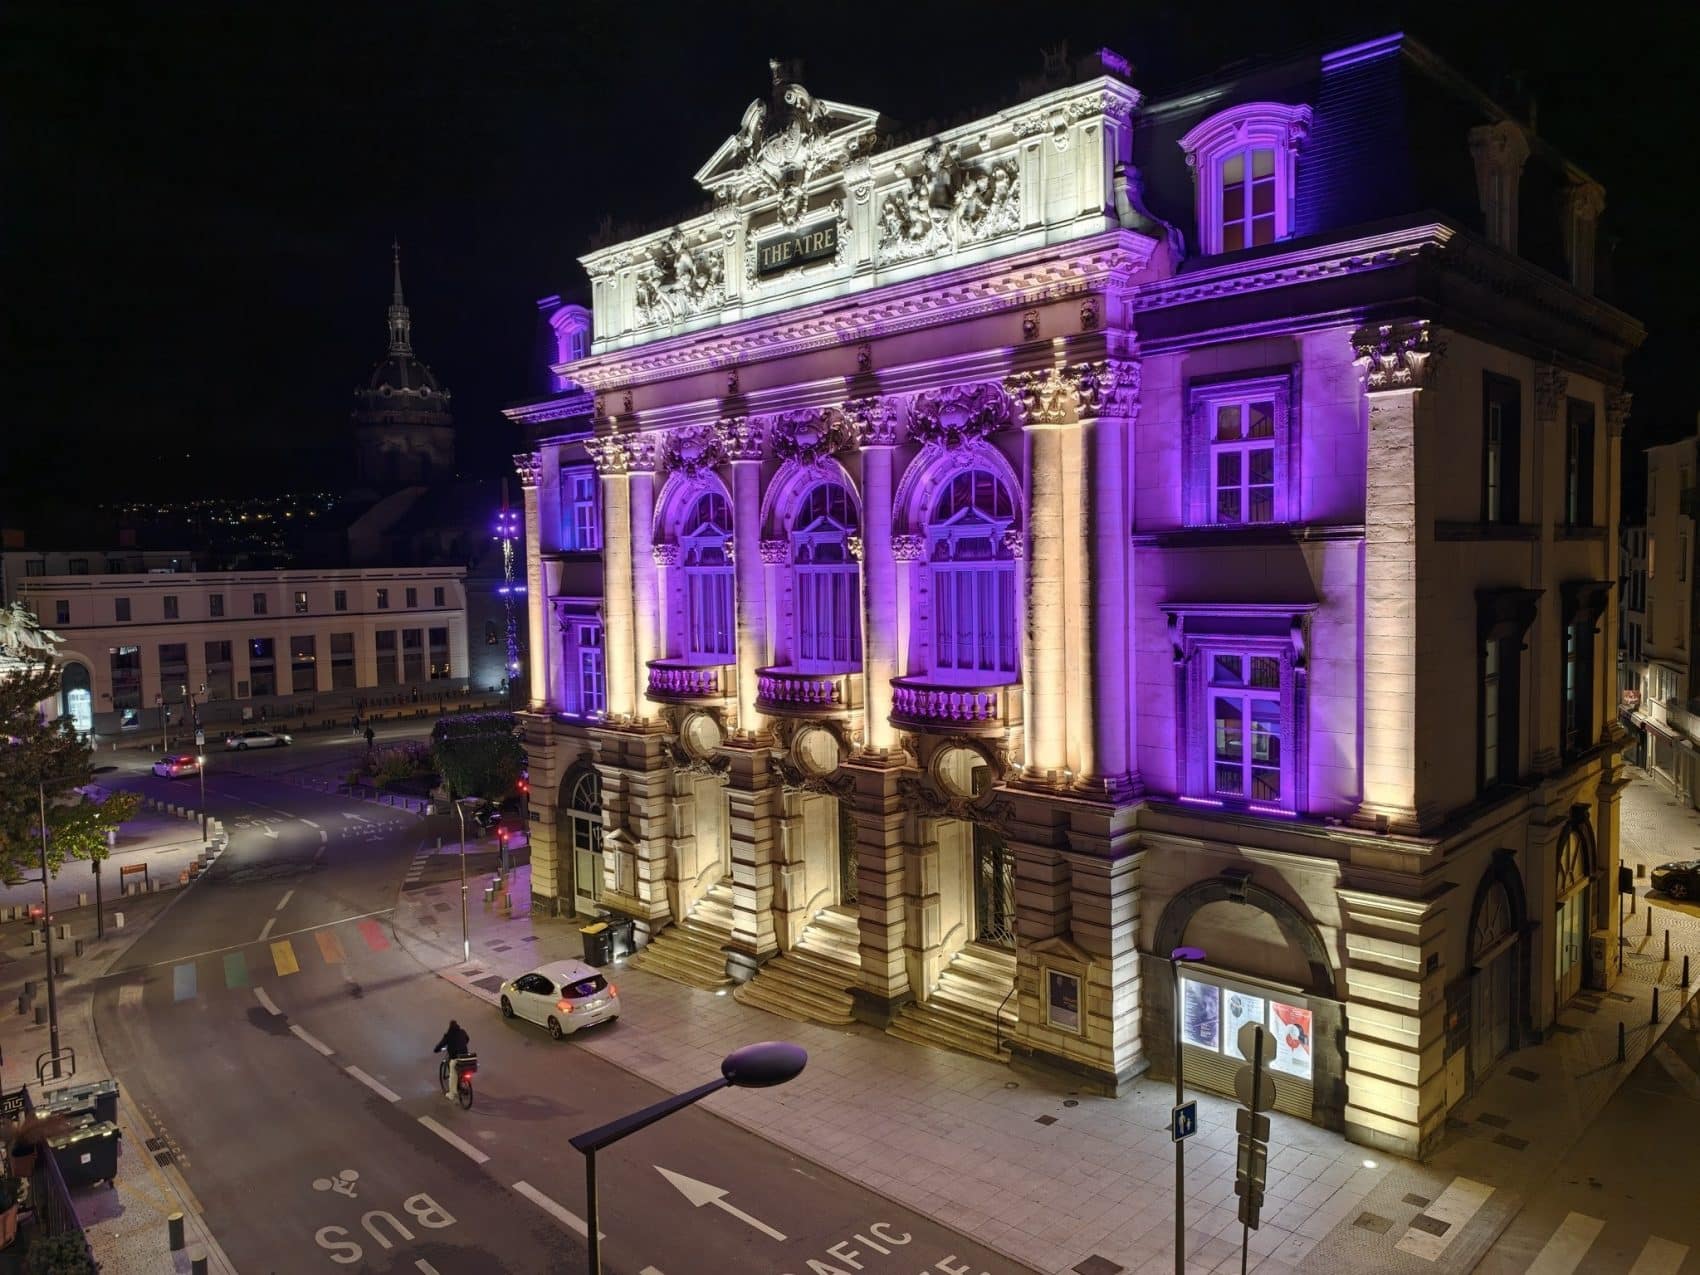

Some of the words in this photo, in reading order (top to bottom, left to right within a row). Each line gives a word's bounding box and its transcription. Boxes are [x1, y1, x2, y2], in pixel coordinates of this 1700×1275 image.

[762, 228, 834, 266] THEATRE
[314, 1193, 458, 1264] BUS
[786, 1222, 912, 1275] AFIC
